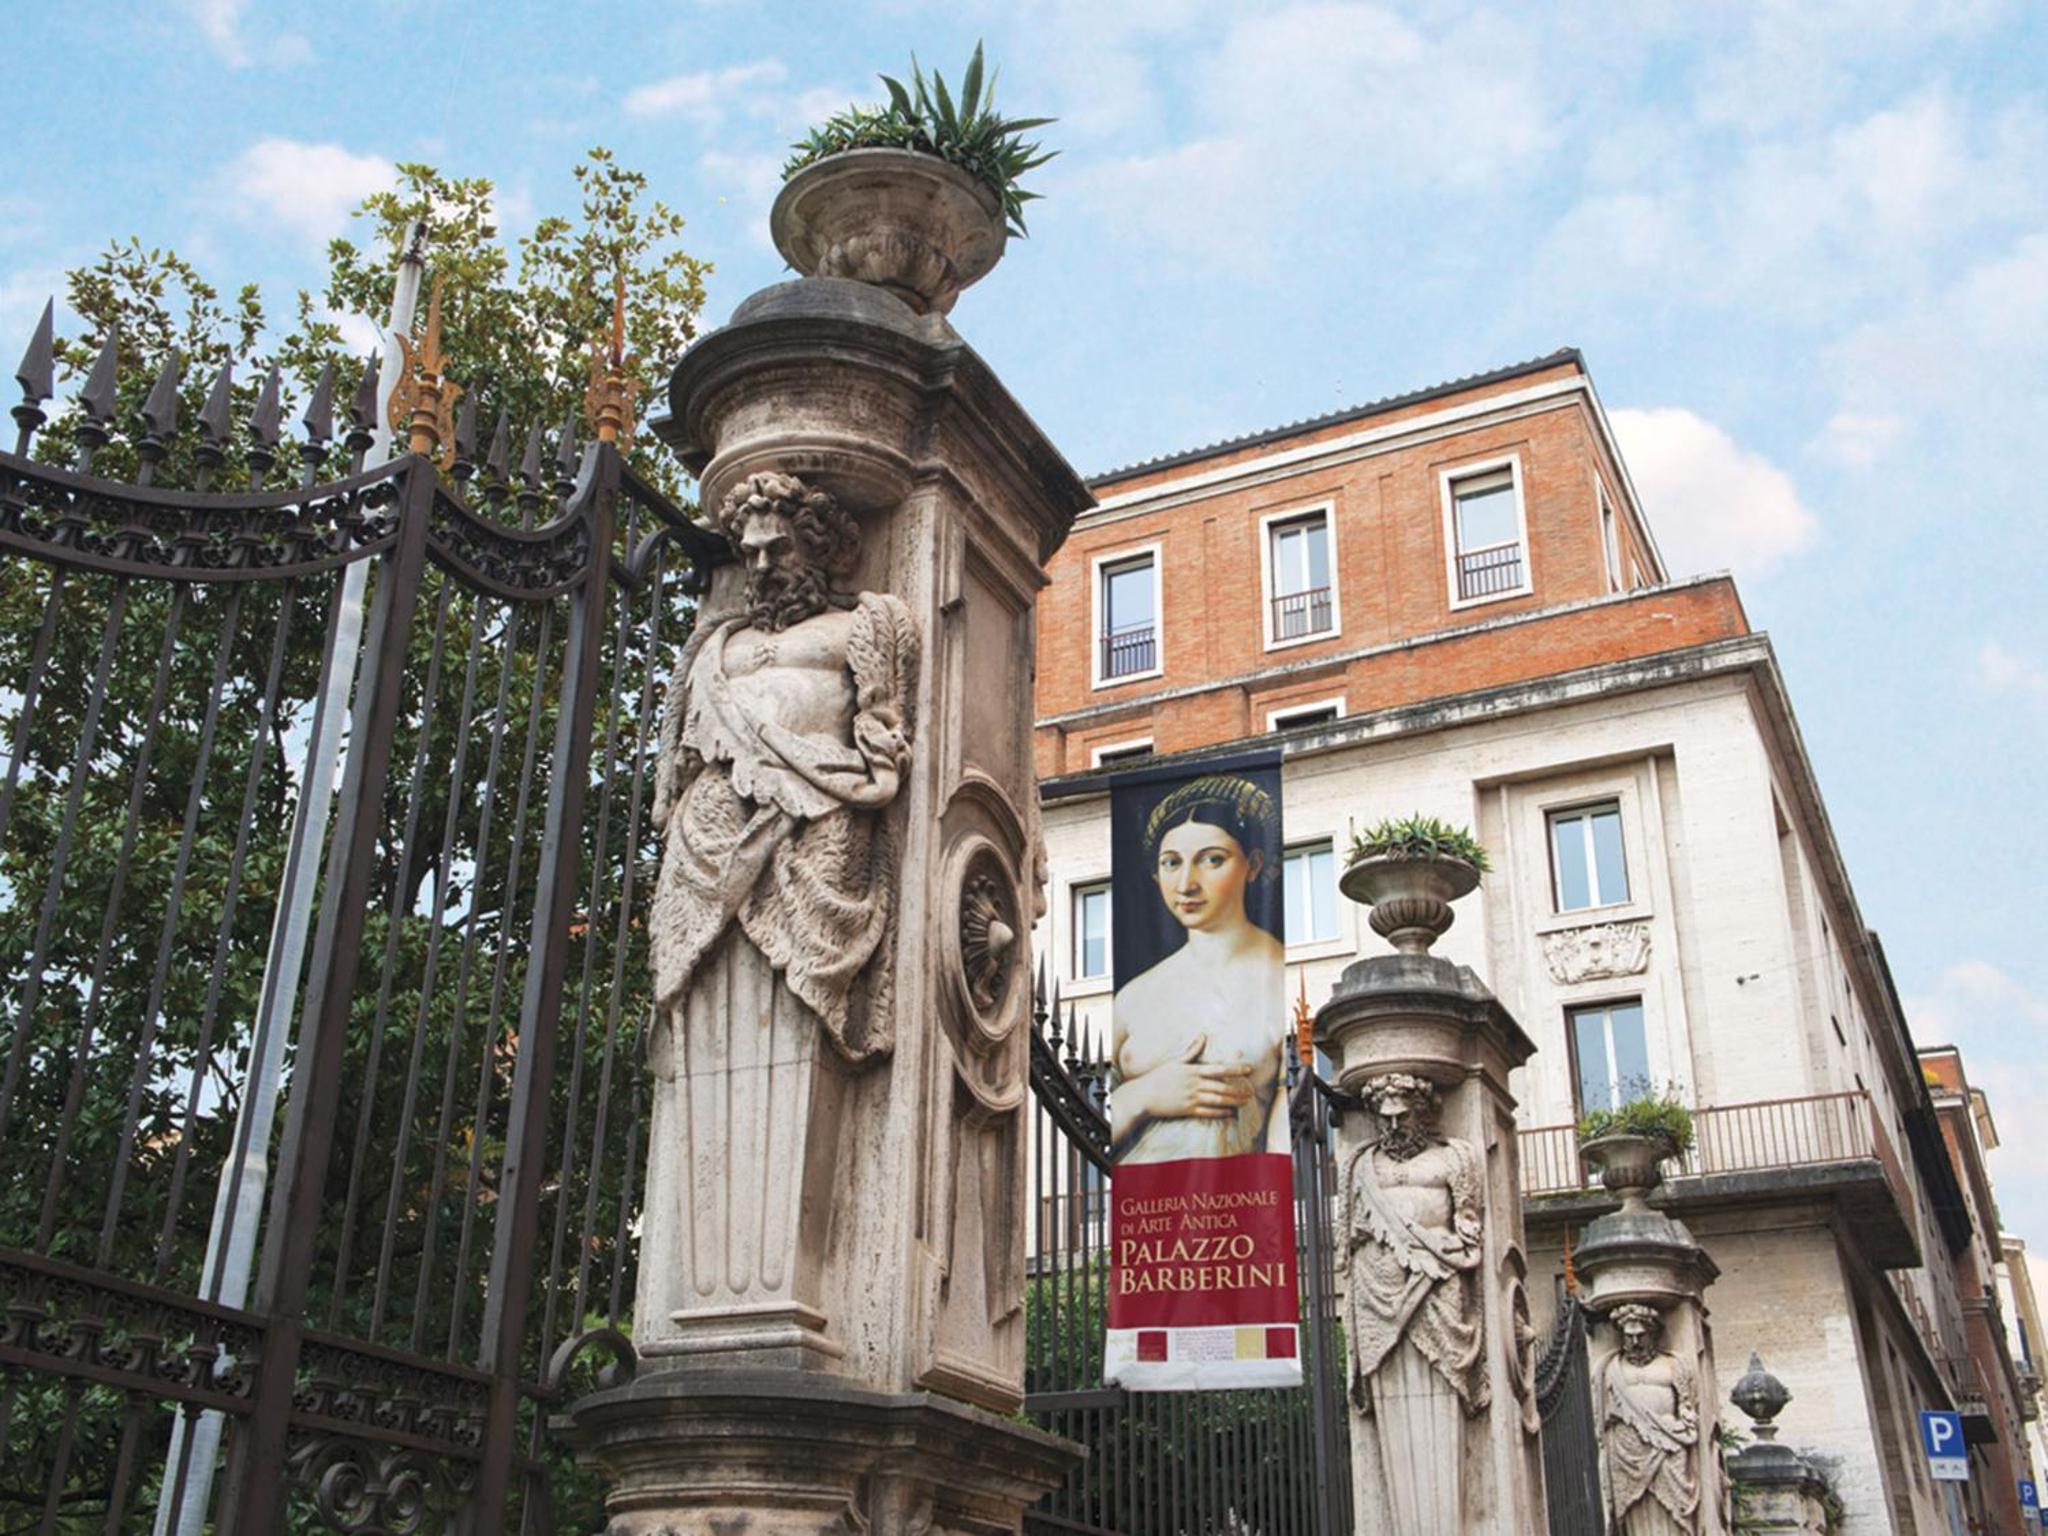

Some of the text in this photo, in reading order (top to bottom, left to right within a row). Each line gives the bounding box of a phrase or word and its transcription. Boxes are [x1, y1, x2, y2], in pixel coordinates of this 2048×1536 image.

[1121, 1191, 1278, 1216] GALLERIA NAZIONALE
[1138, 1217, 1172, 1233] ARTE
[1180, 1214, 1238, 1230] ANTICA
[1120, 1235, 1254, 1267] PALAZZO
[1119, 1264, 1286, 1295] BARBERINI
[1928, 1417, 1953, 1452] P
[2023, 1485, 2033, 1501] P
